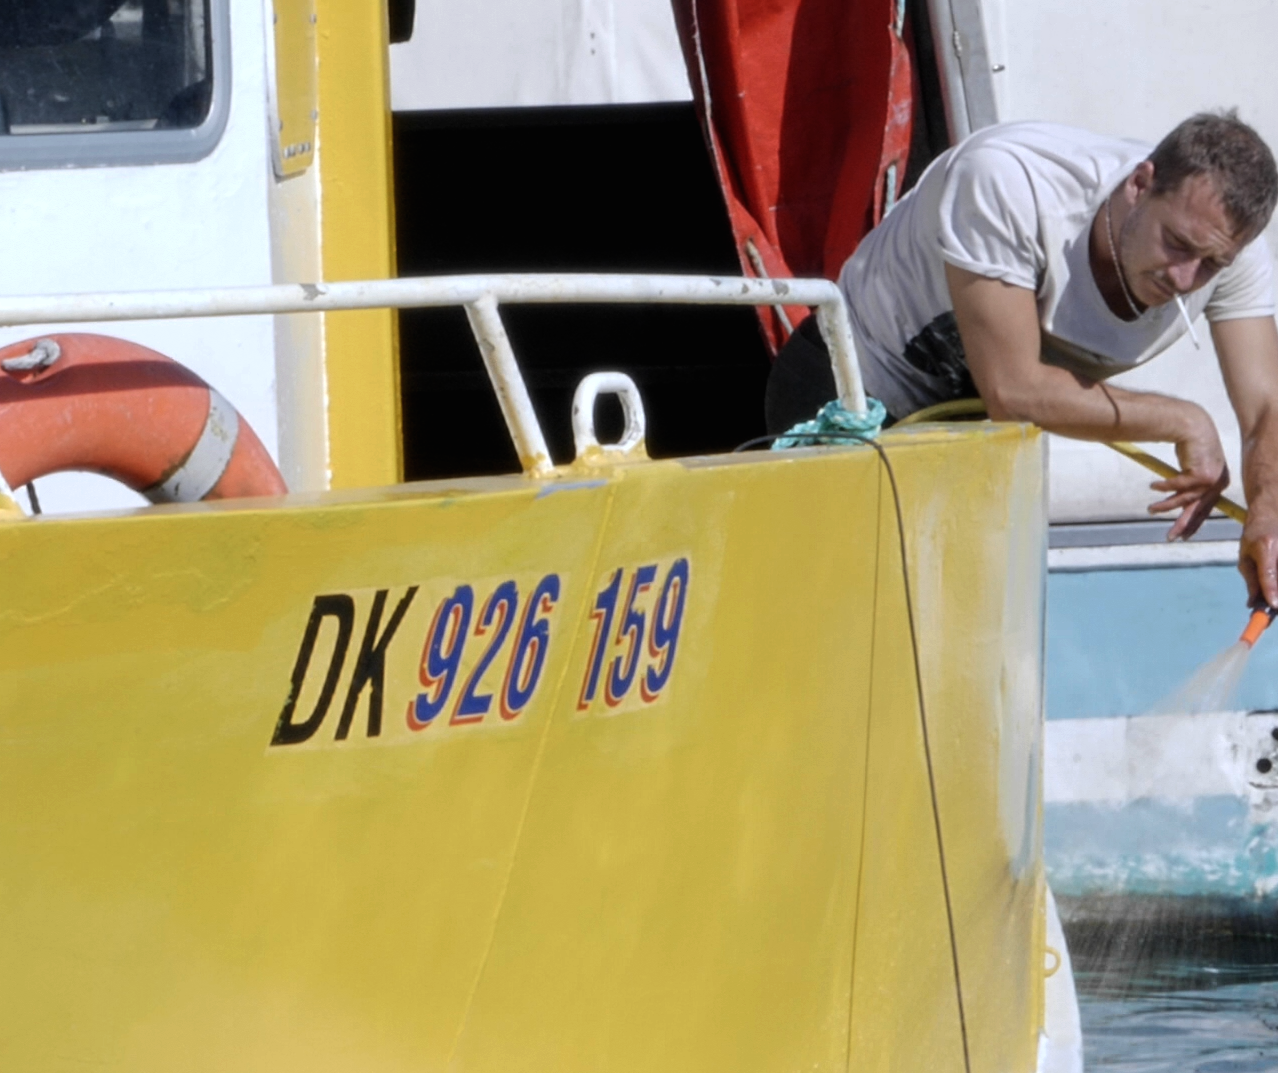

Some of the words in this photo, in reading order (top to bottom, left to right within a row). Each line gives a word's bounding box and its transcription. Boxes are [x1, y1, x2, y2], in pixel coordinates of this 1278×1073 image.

[269, 584, 420, 747] DK
[406, 573, 561, 732] 926
[577, 557, 690, 711] 159
